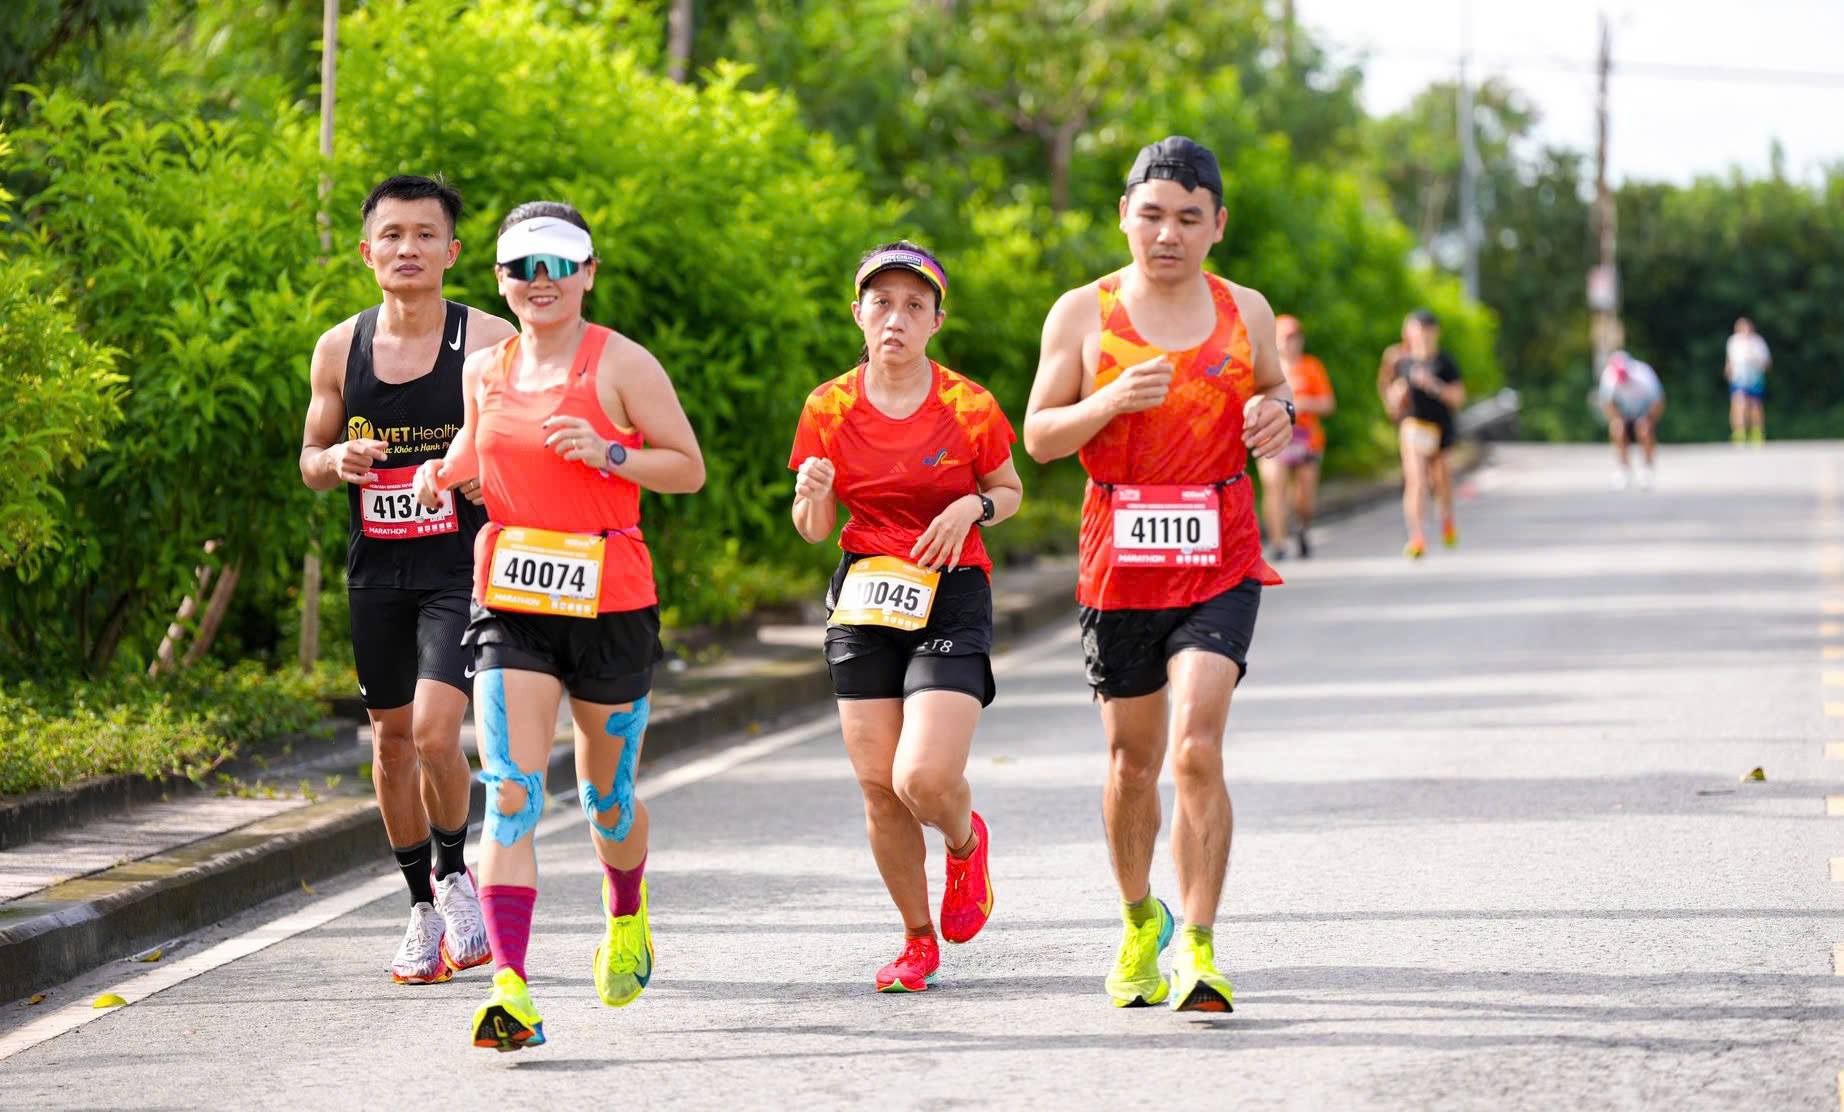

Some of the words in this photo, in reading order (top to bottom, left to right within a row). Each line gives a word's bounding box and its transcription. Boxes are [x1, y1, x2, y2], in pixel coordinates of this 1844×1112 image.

[377, 426, 410, 442] VET
[413, 424, 460, 440] Health
[369, 527, 407, 535] MARATHON
[1131, 516, 1201, 543] 41110
[504, 557, 585, 592] 40074
